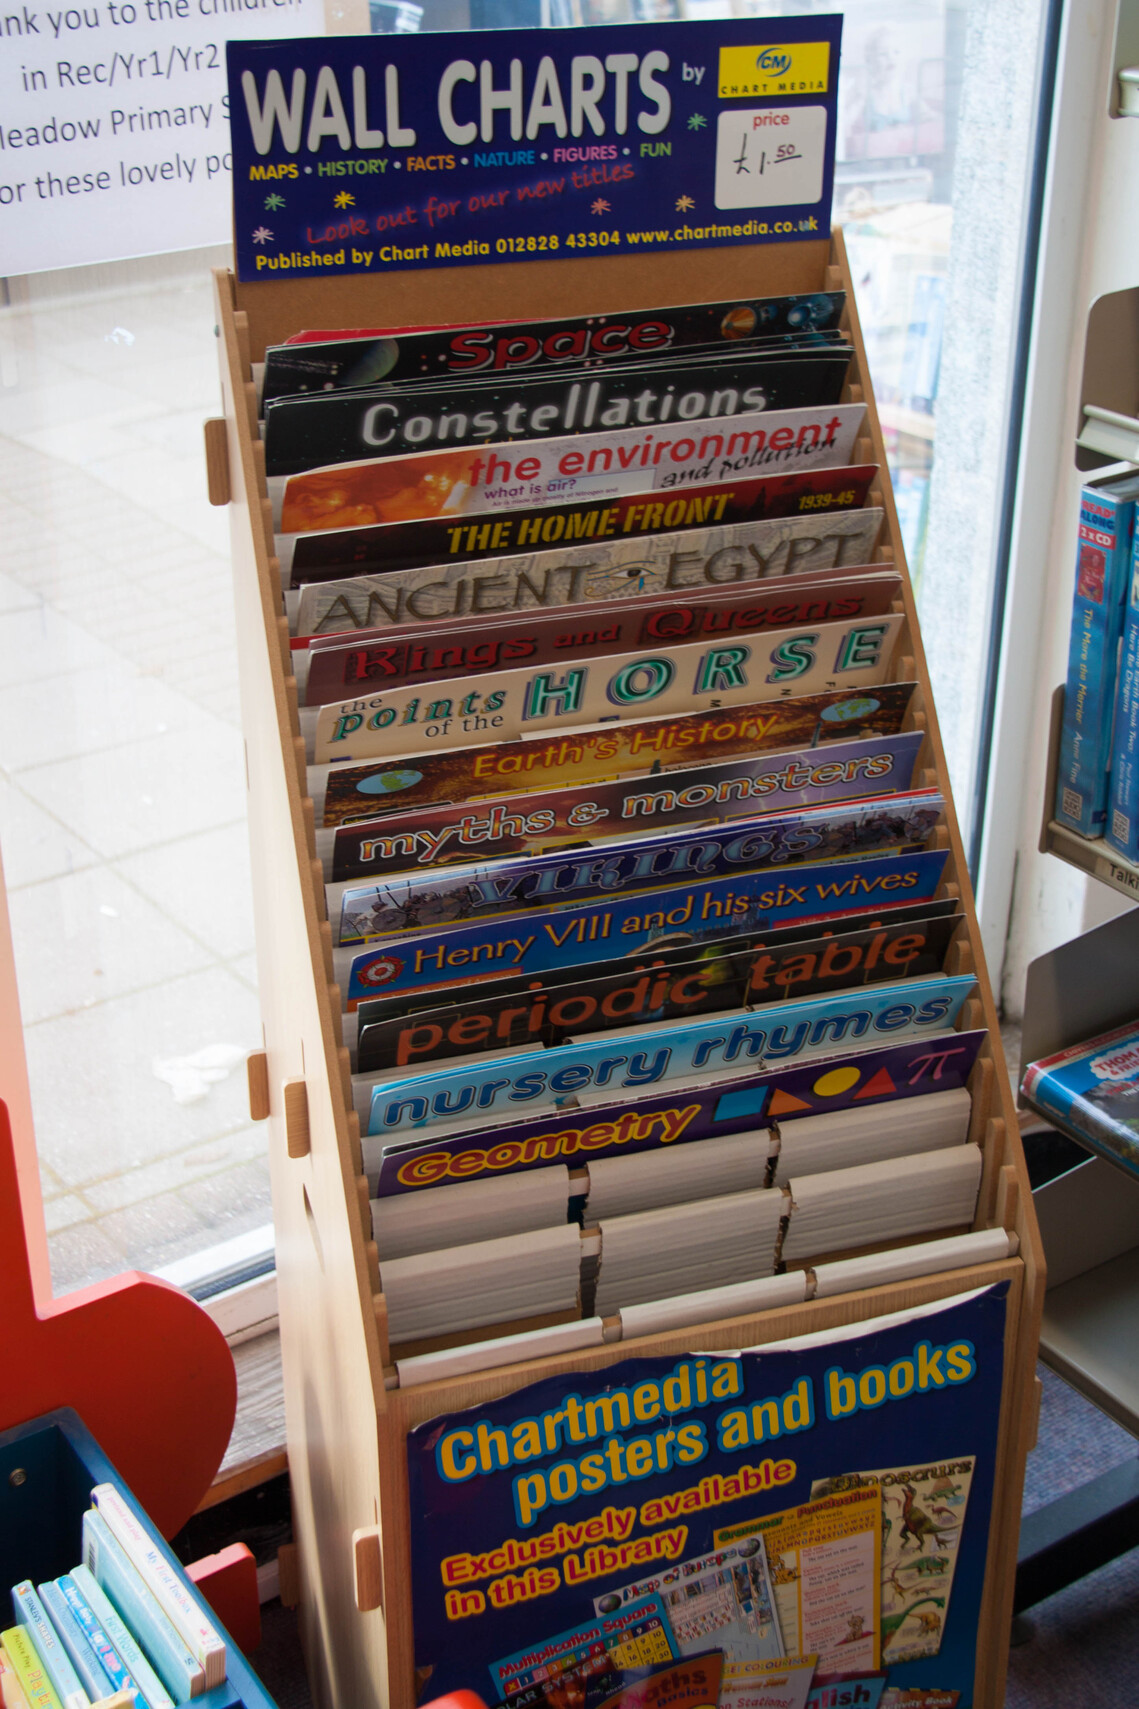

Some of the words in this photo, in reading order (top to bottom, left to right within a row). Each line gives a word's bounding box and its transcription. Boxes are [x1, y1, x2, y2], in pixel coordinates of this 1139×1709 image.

[0, 6, 40, 36] nk
[47, 9, 100, 39] you
[108, 3, 137, 25] to
[147, 0, 190, 21] the
[21, 65, 47, 91] in
[56, 44, 220, 87] Rec/Yr1/Yr2
[721, 83, 768, 95] CHART
[777, 80, 825, 92] MEDIA
[0, 116, 100, 150] eadow
[111, 103, 213, 135] Primary
[241, 64, 417, 155] WALL
[437, 50, 672, 146] CHARTS
[682, 62, 706, 85] by
[752, 112, 791, 131] price
[37, 170, 111, 200] these
[120, 153, 196, 187] lovely
[249, 163, 299, 180] MAPS
[318, 158, 388, 177] HISTORY
[406, 154, 456, 171] FACTS
[473, 150, 535, 168] NATURE
[553, 145, 617, 163] FIGURES
[640, 142, 671, 158] FUN
[306, 216, 369, 244] Look
[376, 205, 418, 232] out
[424, 196, 461, 227] for
[468, 189, 509, 212] our
[517, 177, 565, 201] new
[571, 162, 635, 190] titles
[255, 249, 346, 271] Published
[352, 247, 373, 267] by
[379, 243, 429, 263] Chart
[435, 239, 490, 258] Media
[495, 236, 559, 254] 012828
[565, 230, 620, 249] 43304
[626, 215, 818, 245] www.chartmedia.co.uk
[447, 320, 675, 372] Space
[361, 381, 767, 446] Constellations
[467, 453, 542, 487] the
[558, 416, 842, 476] environment
[661, 456, 716, 489] and
[720, 436, 838, 480] pollution
[484, 482, 527, 500] what
[529, 480, 541, 495] is
[546, 478, 577, 493] air?
[447, 522, 513, 554] THE
[516, 508, 619, 546] HOME
[622, 493, 735, 533] FRONT
[798, 490, 855, 511] 1939-45
[1080, 510, 1115, 531] ALONG
[1081, 527, 1087, 537] 2
[1095, 533, 1112, 547] CD
[313, 562, 597, 633] ANCIENT
[663, 531, 865, 590] EGYPT
[354, 635, 538, 681] Kings
[553, 623, 622, 648] and
[646, 596, 865, 639] Queens
[1083, 608, 1094, 628] The
[1128, 623, 1139, 651] Here
[1080, 631, 1092, 661] More
[327, 688, 507, 744] points
[522, 622, 891, 722] HORSE
[1078, 662, 1090, 681] the
[340, 698, 382, 715] the
[425, 720, 451, 738] of
[462, 715, 504, 733] the
[1075, 683, 1088, 725] Merrier
[474, 737, 618, 780] Earth's
[628, 713, 780, 755] History
[1072, 731, 1083, 760] Anne
[1069, 760, 1081, 784] Fine
[359, 806, 555, 863] myths
[568, 803, 609, 826] &
[621, 753, 895, 819] monsters
[414, 935, 537, 974] Henry
[543, 912, 613, 947] VIII
[621, 895, 695, 935] and
[701, 891, 750, 920] his
[759, 883, 810, 909] six
[815, 870, 919, 902] wives
[396, 972, 713, 1066] periodic
[750, 932, 926, 991] table
[383, 1047, 673, 1127] nursery
[691, 996, 953, 1068] rhymes
[397, 1104, 702, 1187] Geometry
[437, 1358, 743, 1482] Chartmedia
[514, 1421, 707, 1527] posters
[718, 1377, 813, 1451] and
[826, 1341, 973, 1419] books
[831, 1459, 973, 1493] Dinosaurs
[443, 1508, 635, 1585] Exclusively
[642, 1460, 796, 1525] available
[717, 1514, 784, 1542] Grammar
[797, 1487, 878, 1519] Punctuation
[446, 1590, 484, 1618] in
[490, 1568, 559, 1606] this
[566, 1527, 687, 1584] Library
[623, 1578, 660, 1601] Map
[37, 1621, 56, 1650] SHAPES
[116, 1635, 139, 1663] Words
[498, 1627, 601, 1679] Multiplication
[602, 1602, 658, 1634] Square
